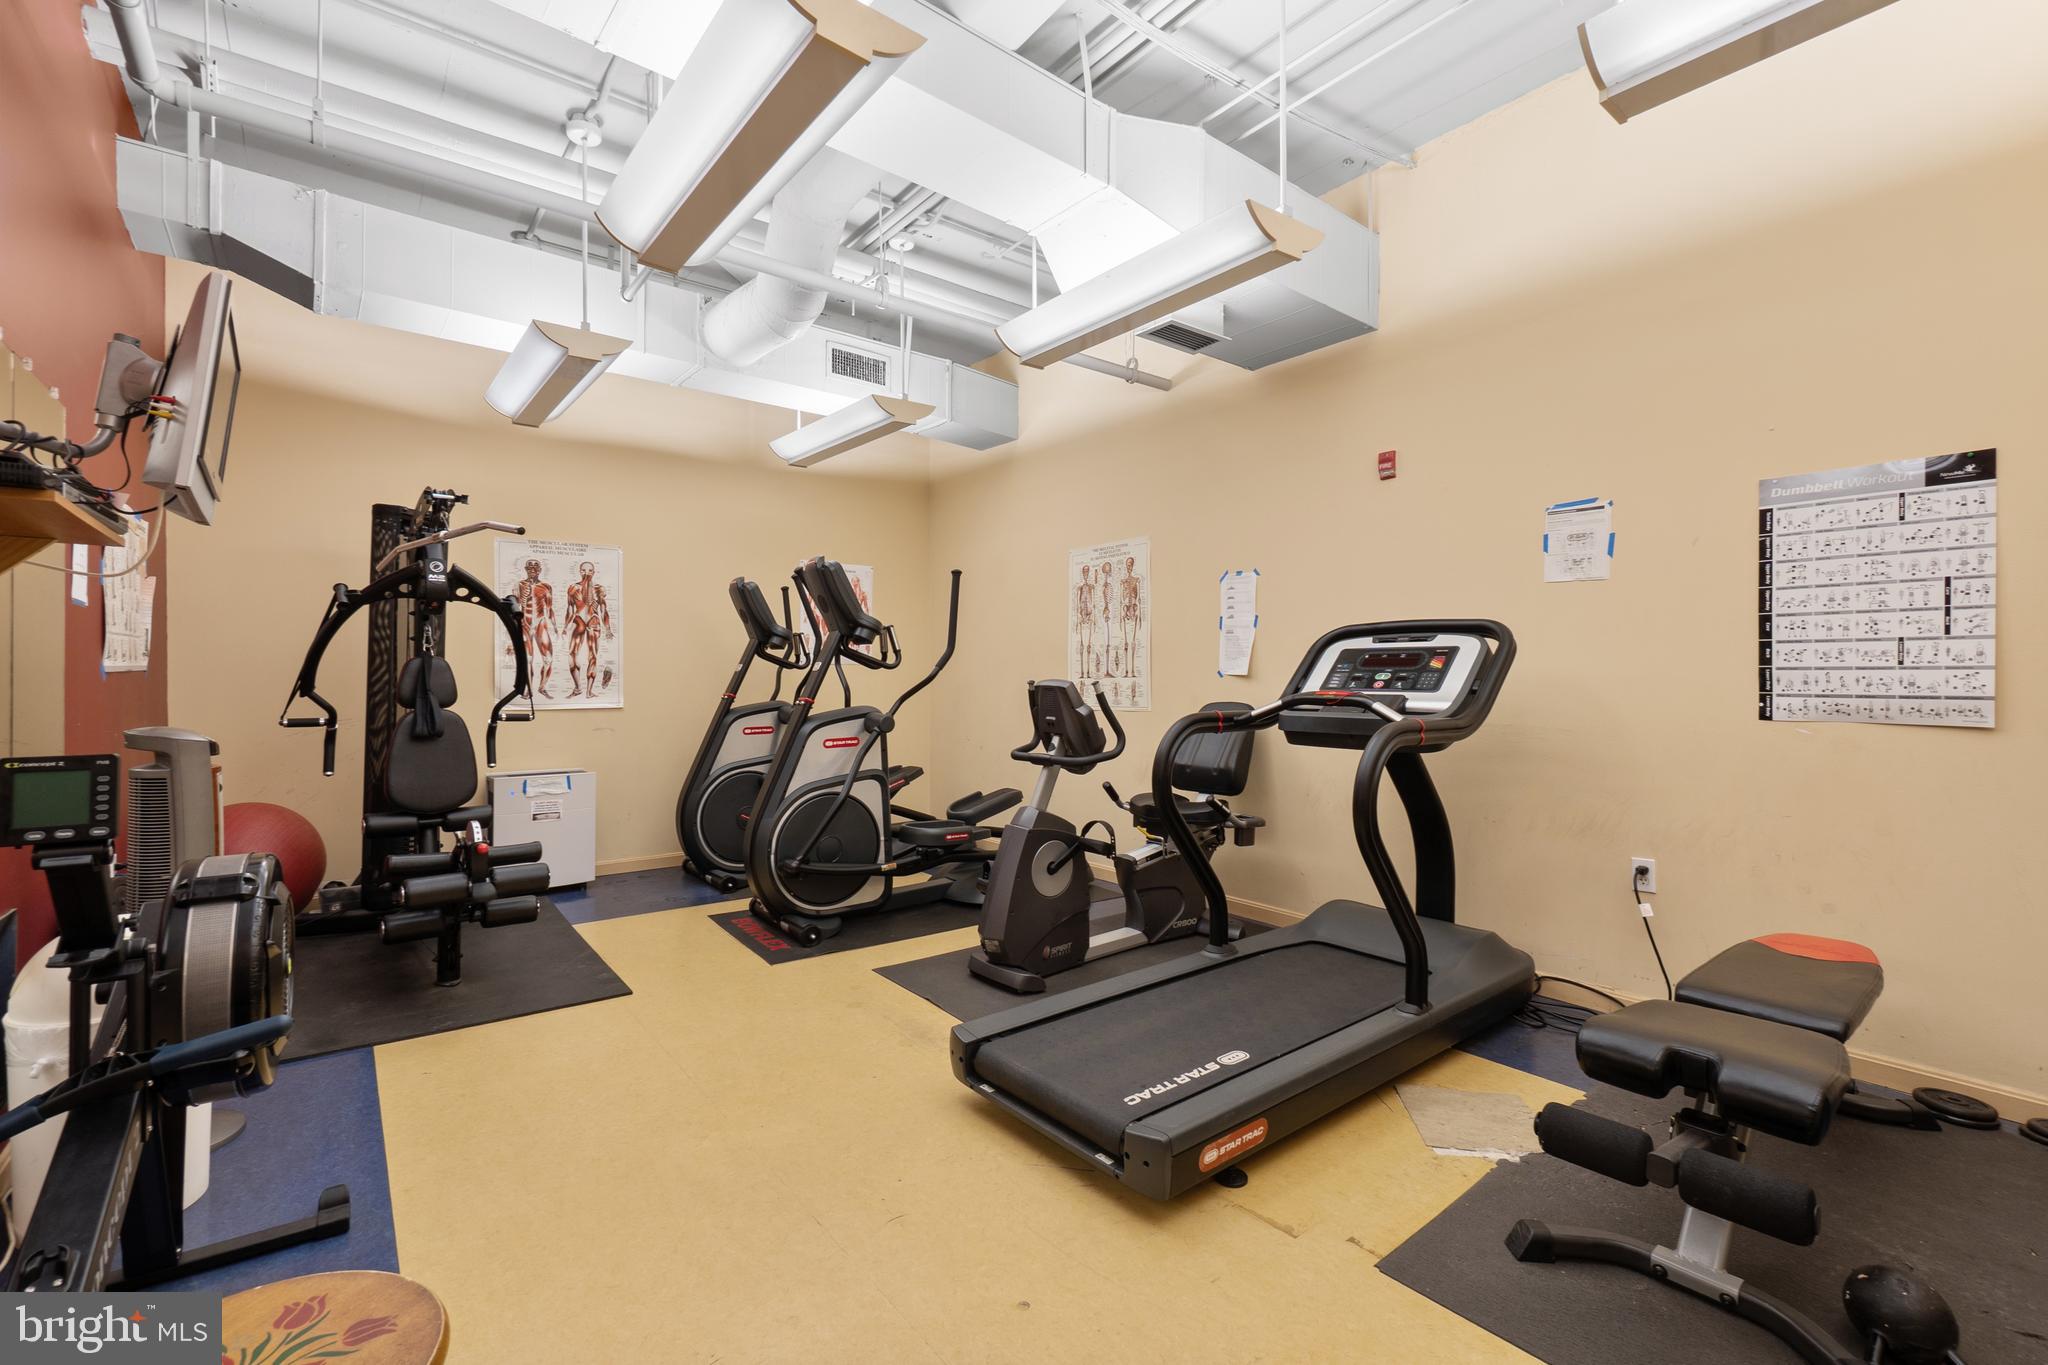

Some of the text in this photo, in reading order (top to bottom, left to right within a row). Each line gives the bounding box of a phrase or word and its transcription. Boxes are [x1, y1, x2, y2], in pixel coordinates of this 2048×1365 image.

[1771, 470, 1915, 498] Dumbbell Workout
[732, 917, 791, 951] BOWFLEX
[1051, 942, 1072, 954] SPIRIT
[1123, 1061, 1221, 1106] STAR TRAC
[1219, 1126, 1265, 1155] STAR TRAC
